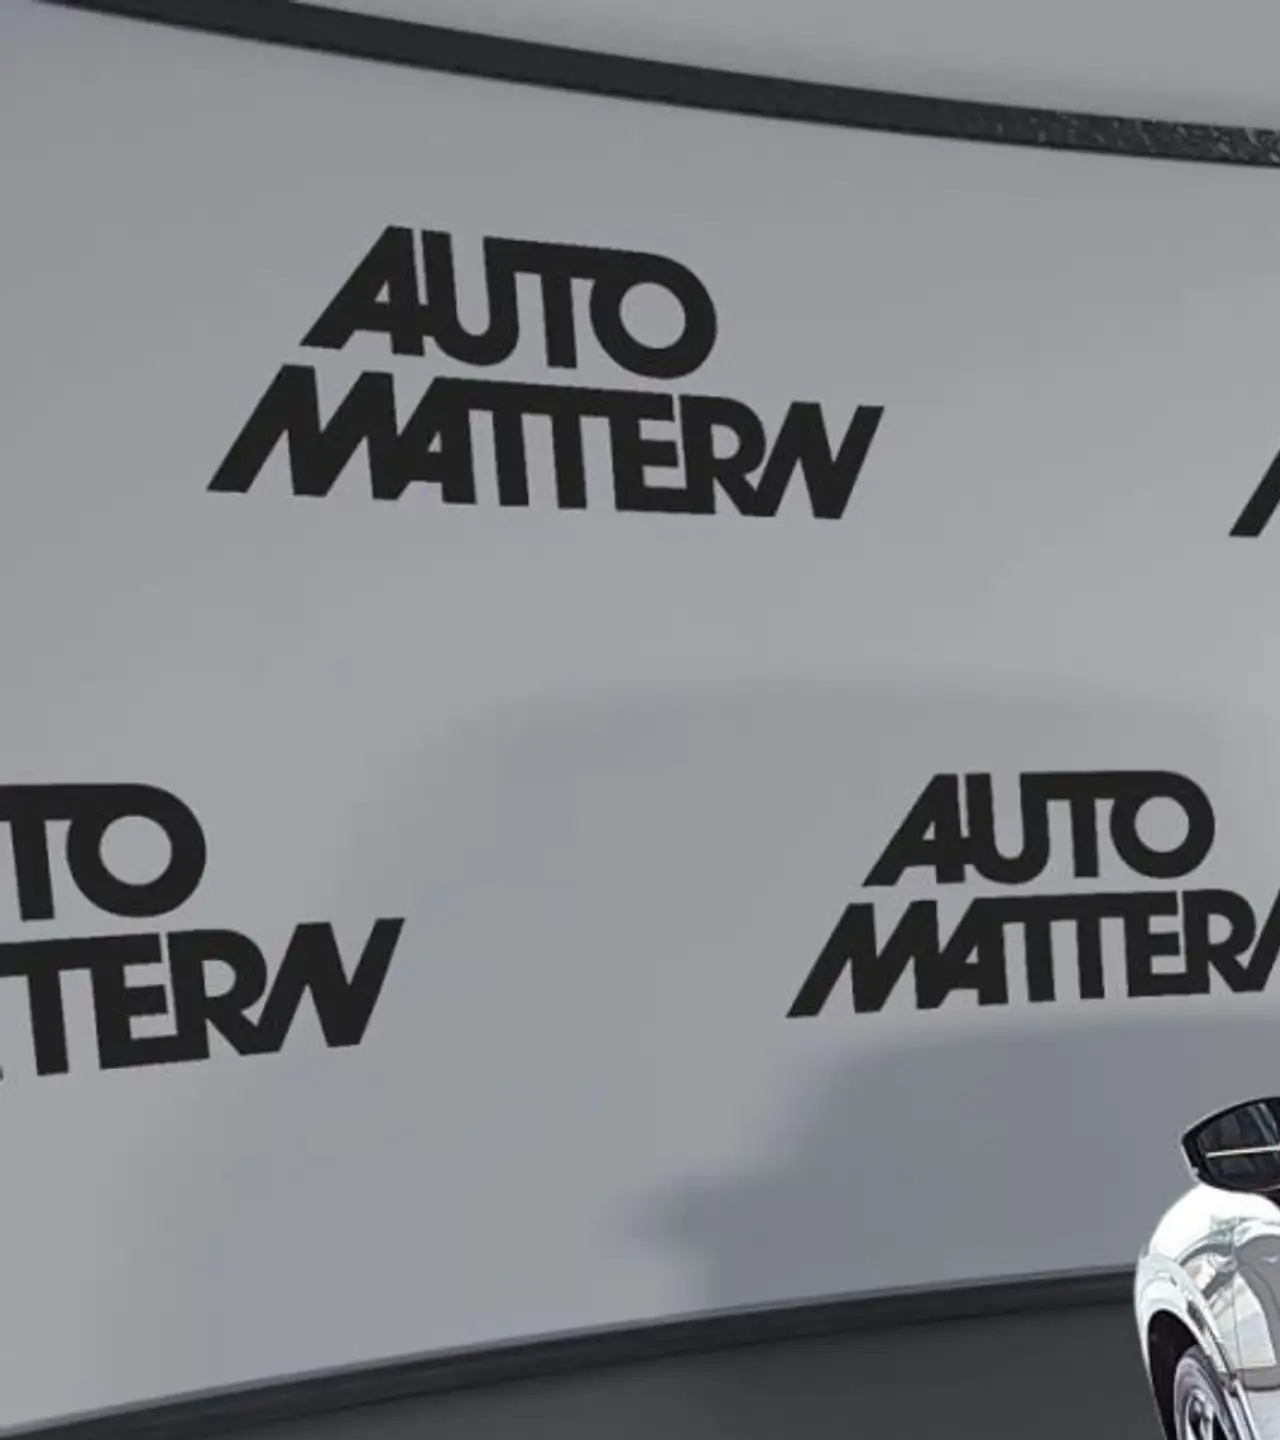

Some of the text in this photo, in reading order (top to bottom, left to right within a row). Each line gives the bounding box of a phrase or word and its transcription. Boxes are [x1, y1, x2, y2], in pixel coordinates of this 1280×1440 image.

[301, 226, 716, 378] AUTO
[208, 365, 884, 519] MATTERN
[863, 771, 1214, 886] AUTO
